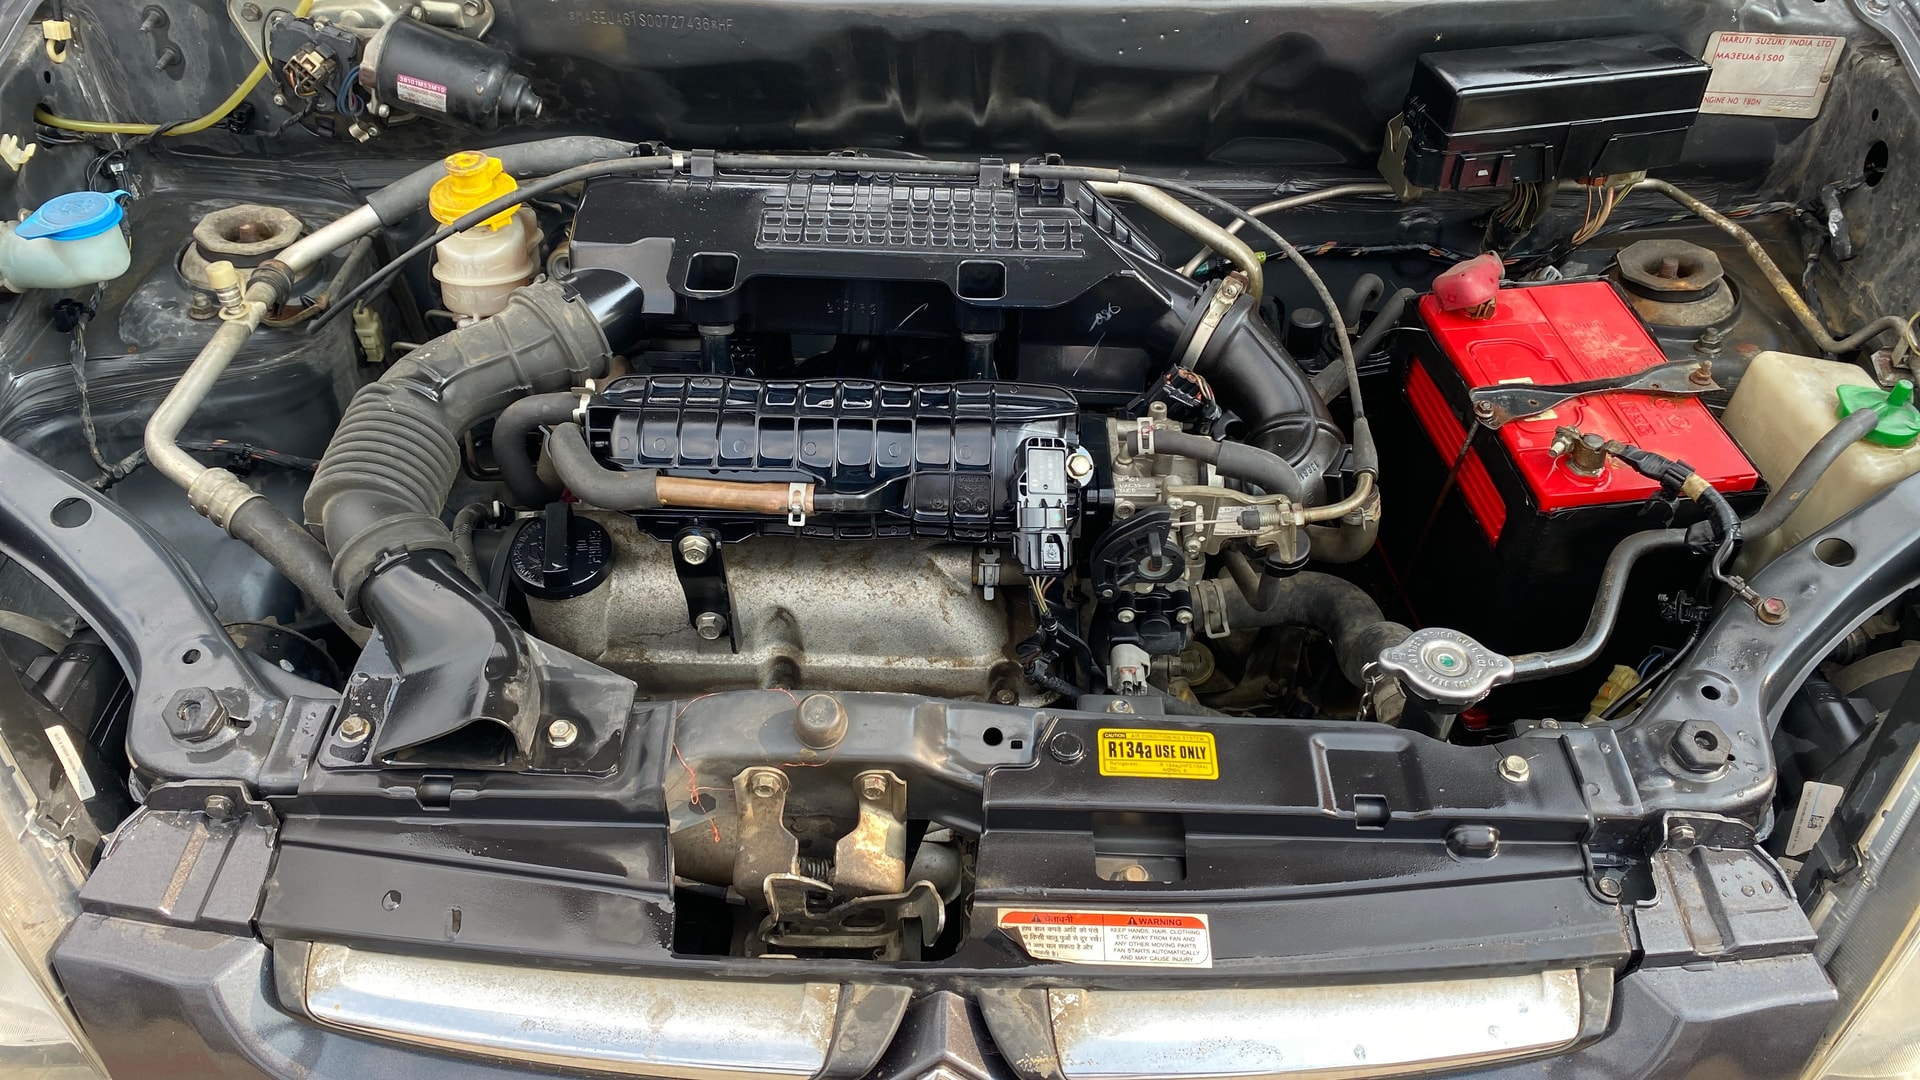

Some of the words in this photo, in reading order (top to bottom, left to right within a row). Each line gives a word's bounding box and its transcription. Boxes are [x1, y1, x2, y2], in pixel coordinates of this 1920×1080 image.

[1720, 36, 1753, 44] MARUTI
[1755, 37, 1786, 46] SUZUKI
[1789, 38, 1813, 47] INDIA
[1704, 96, 1725, 104] NGINE
[1727, 97, 1739, 105] NO
[1108, 741, 1153, 759] R134a
[1155, 744, 1176, 759] USE
[1179, 745, 1206, 760] ONLY
[1044, 914, 1073, 924] चेतावनी
[1138, 918, 1182, 926] WARNING
